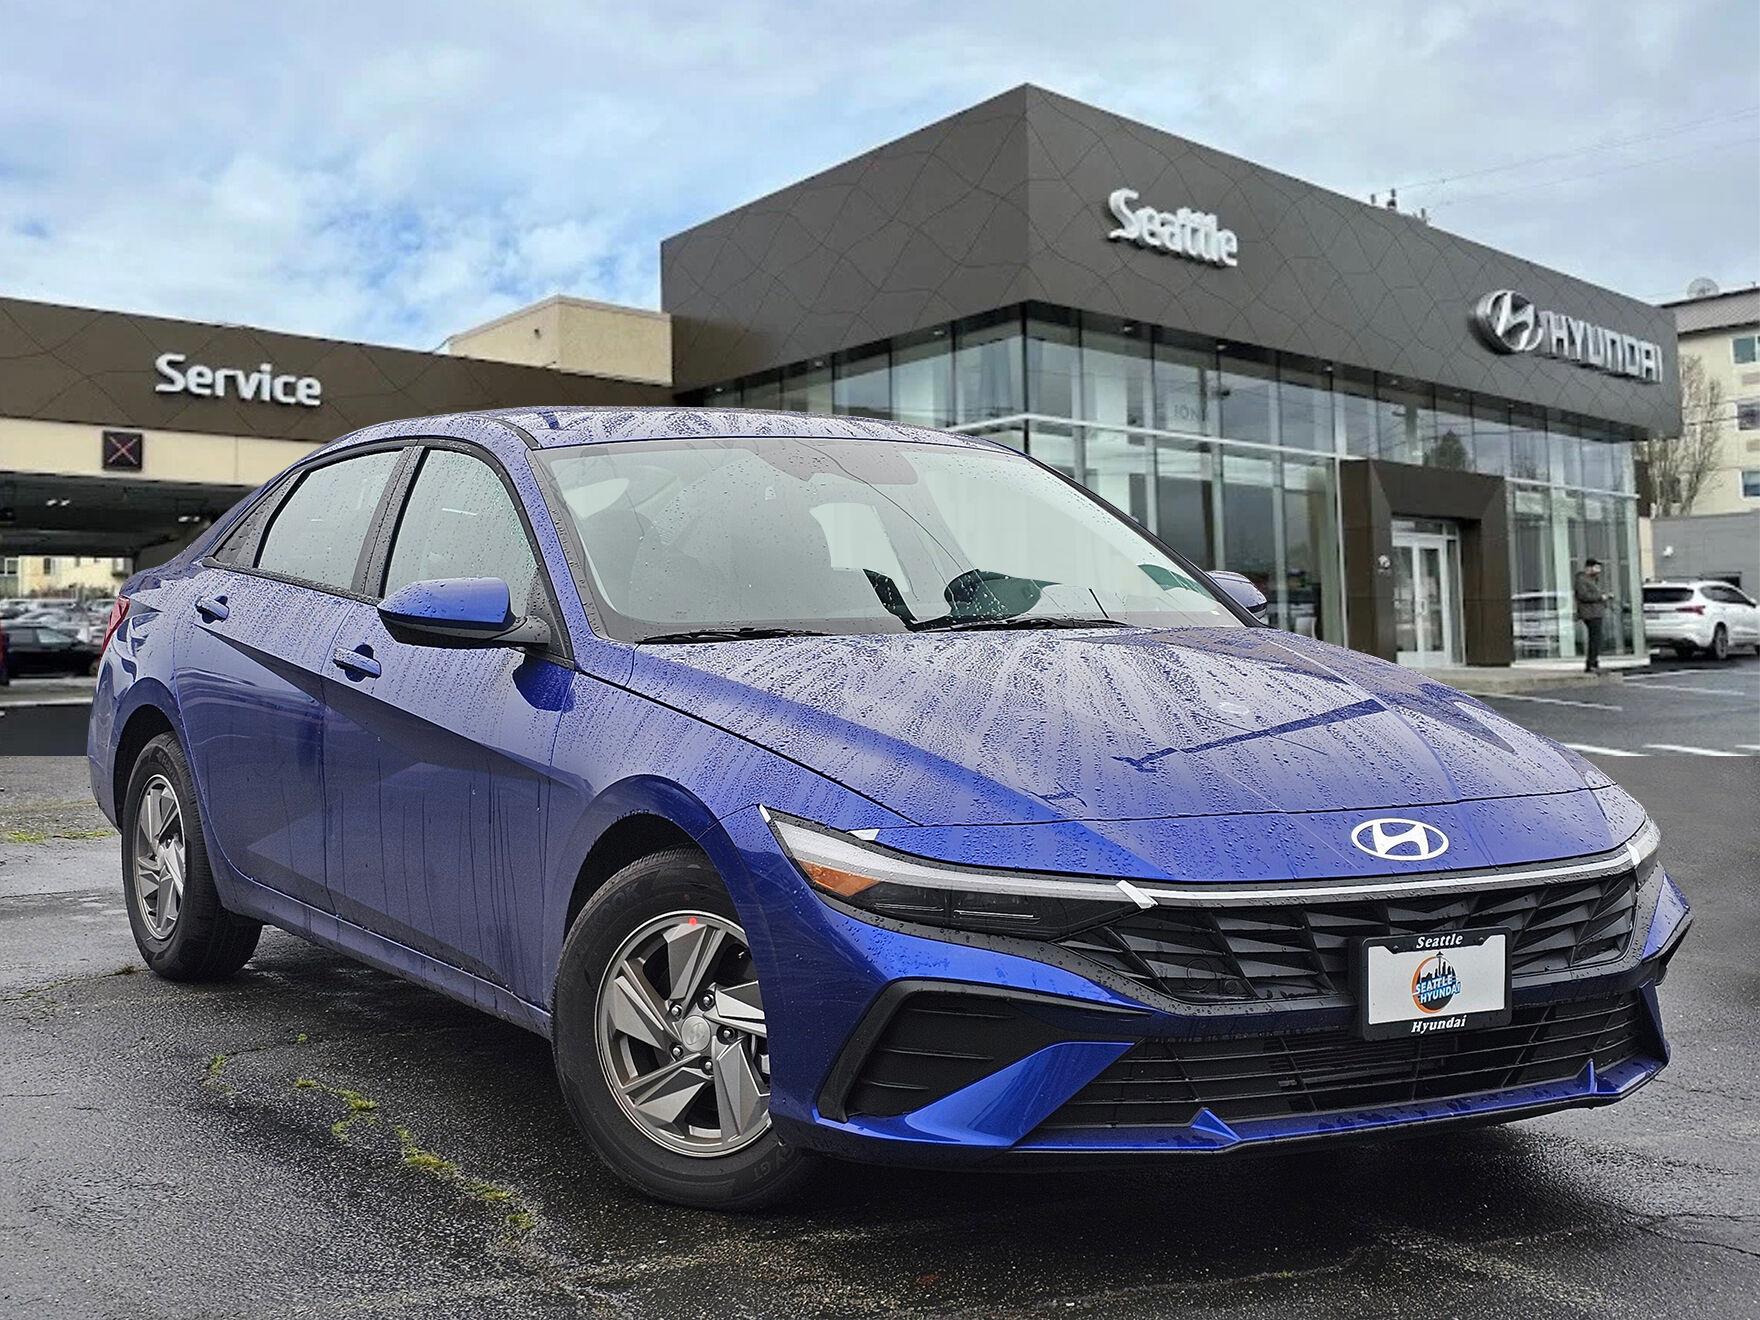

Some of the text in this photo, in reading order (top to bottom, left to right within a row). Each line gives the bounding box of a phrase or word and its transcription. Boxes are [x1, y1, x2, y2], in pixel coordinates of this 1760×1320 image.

[1108, 188, 1238, 267] Seattle
[1540, 311, 1663, 384] HYUNDAI
[155, 353, 322, 407] Service
[1416, 934, 1463, 948] Seattle
[1415, 975, 1453, 994] SEATTLE
[1420, 982, 1461, 1003] HYUNDAI
[1411, 1015, 1467, 1034] Hyundai
